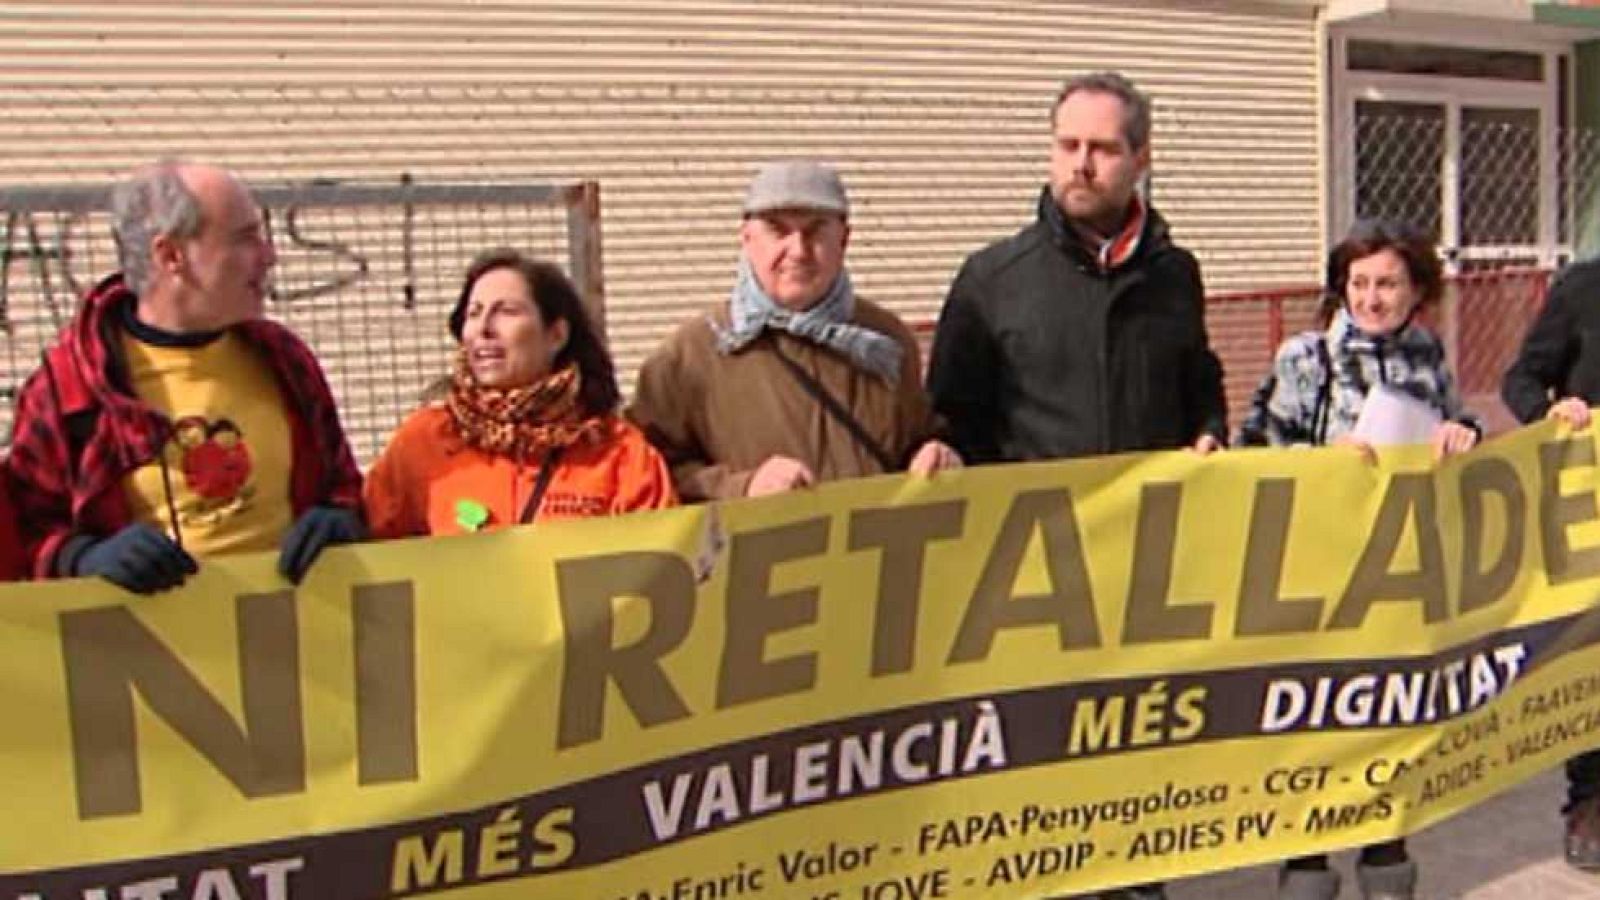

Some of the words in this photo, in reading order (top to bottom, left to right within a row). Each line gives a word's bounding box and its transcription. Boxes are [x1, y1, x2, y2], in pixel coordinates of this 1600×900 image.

[58, 579, 419, 821] NI
[556, 436, 1600, 751] RETALLADE
[391, 807, 576, 891] MÉS
[642, 701, 1007, 842] VALENCIÀ
[1067, 681, 1208, 754] MÉS
[1260, 643, 1526, 732] DIGNITAT
[778, 841, 879, 883] Valor
[1264, 765, 1334, 796] CGT
[987, 841, 1096, 888] AVDIP
[1127, 818, 1225, 861] ADIES
[1236, 809, 1277, 843] PV
